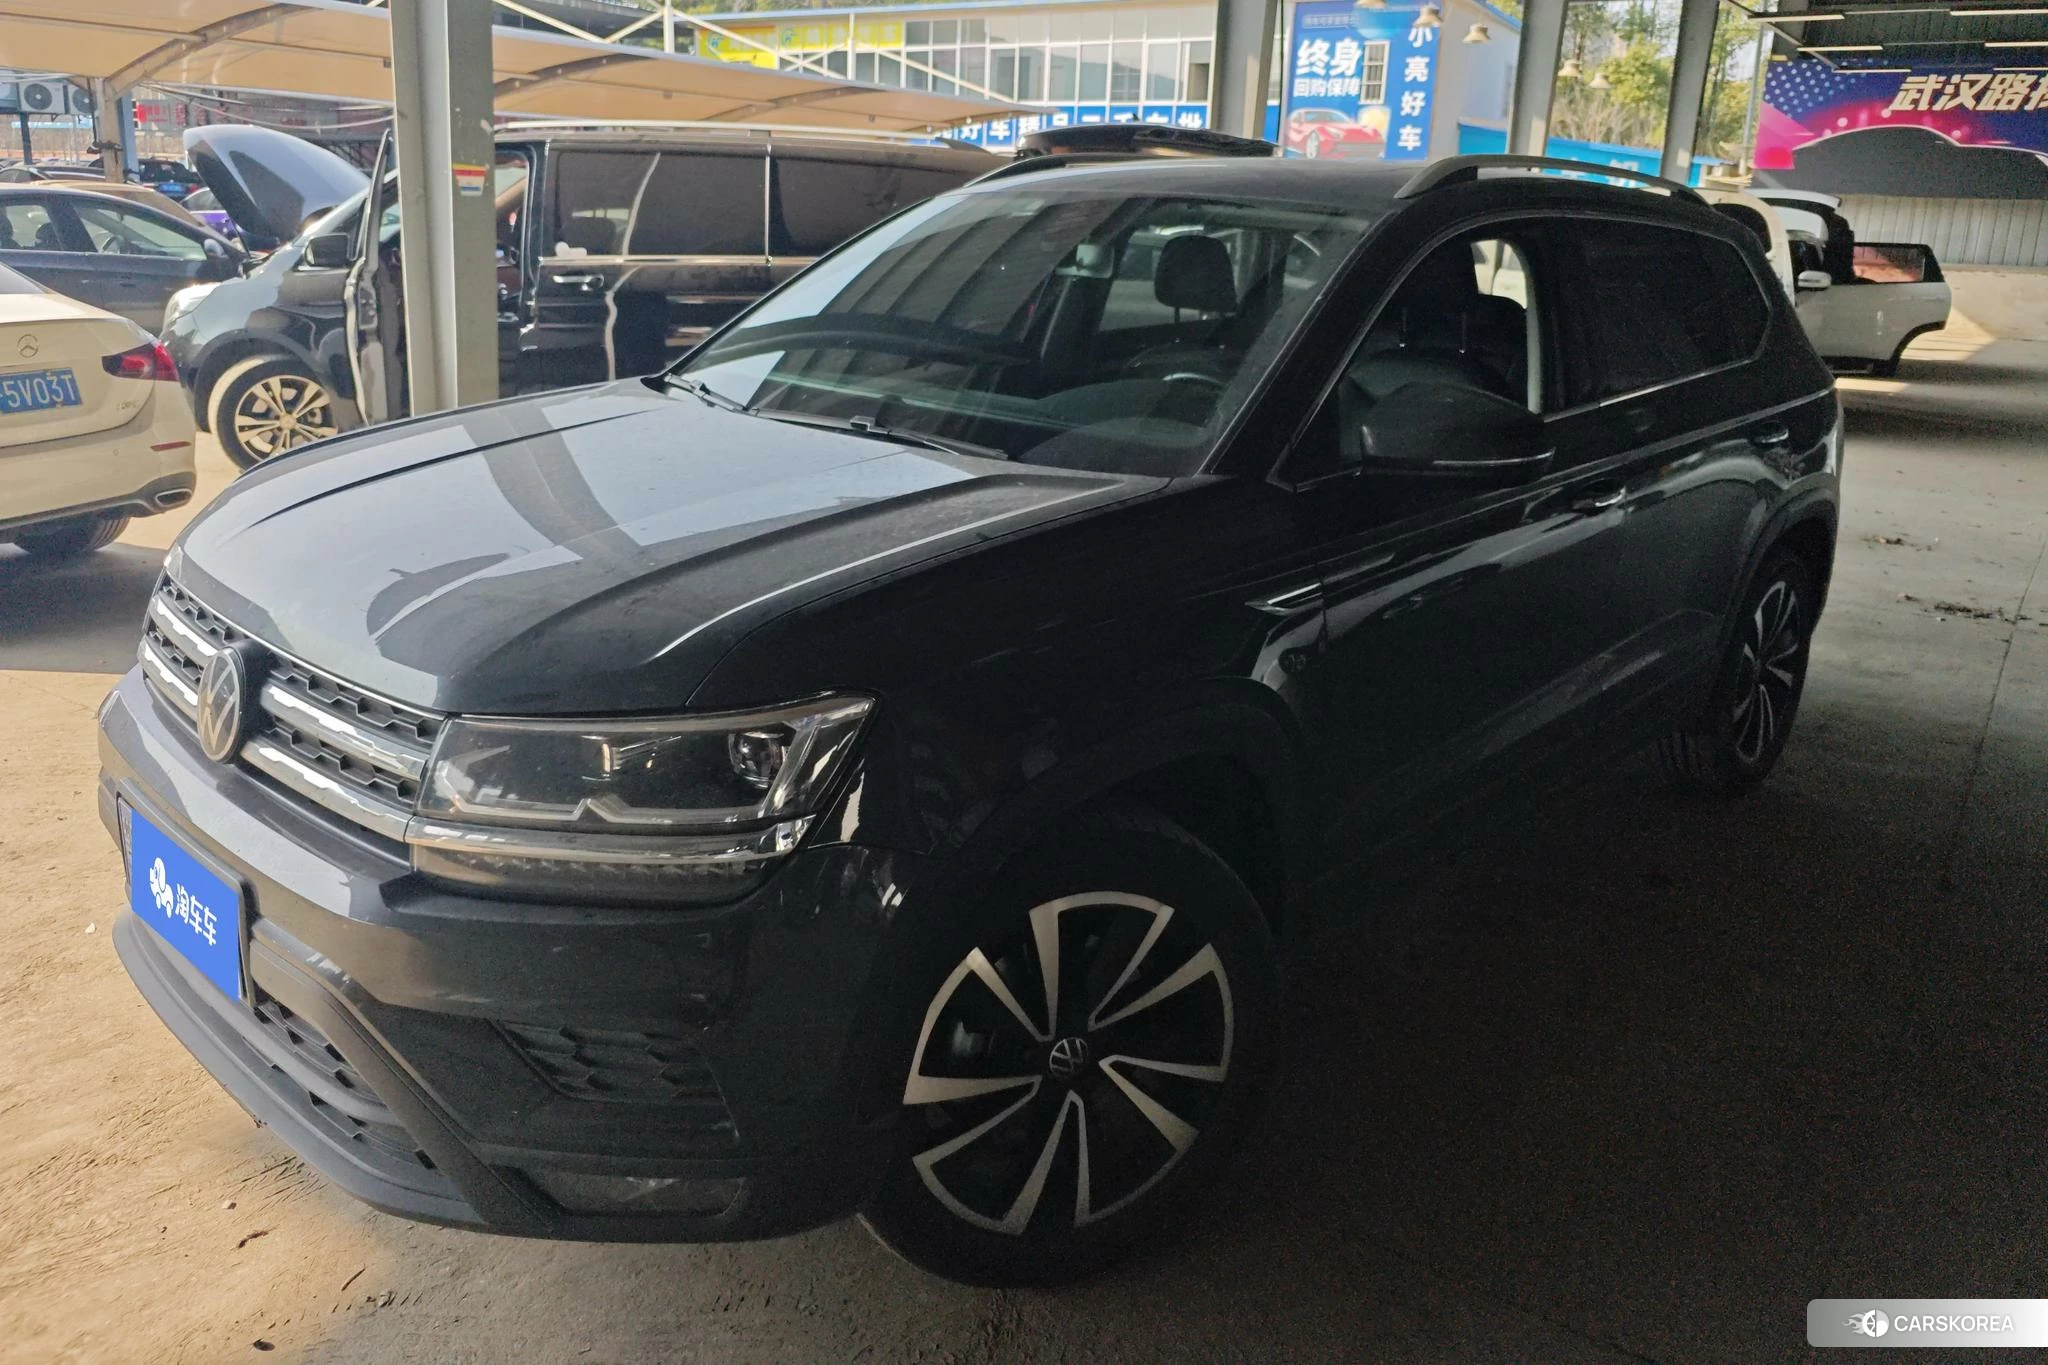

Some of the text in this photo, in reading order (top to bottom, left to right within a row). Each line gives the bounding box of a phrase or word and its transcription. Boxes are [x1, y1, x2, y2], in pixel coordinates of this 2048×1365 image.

[1296, 38, 1362, 76] 终身
[1293, 77, 1361, 97] 回购保障
[1397, 27, 1433, 151] 小亮好车
